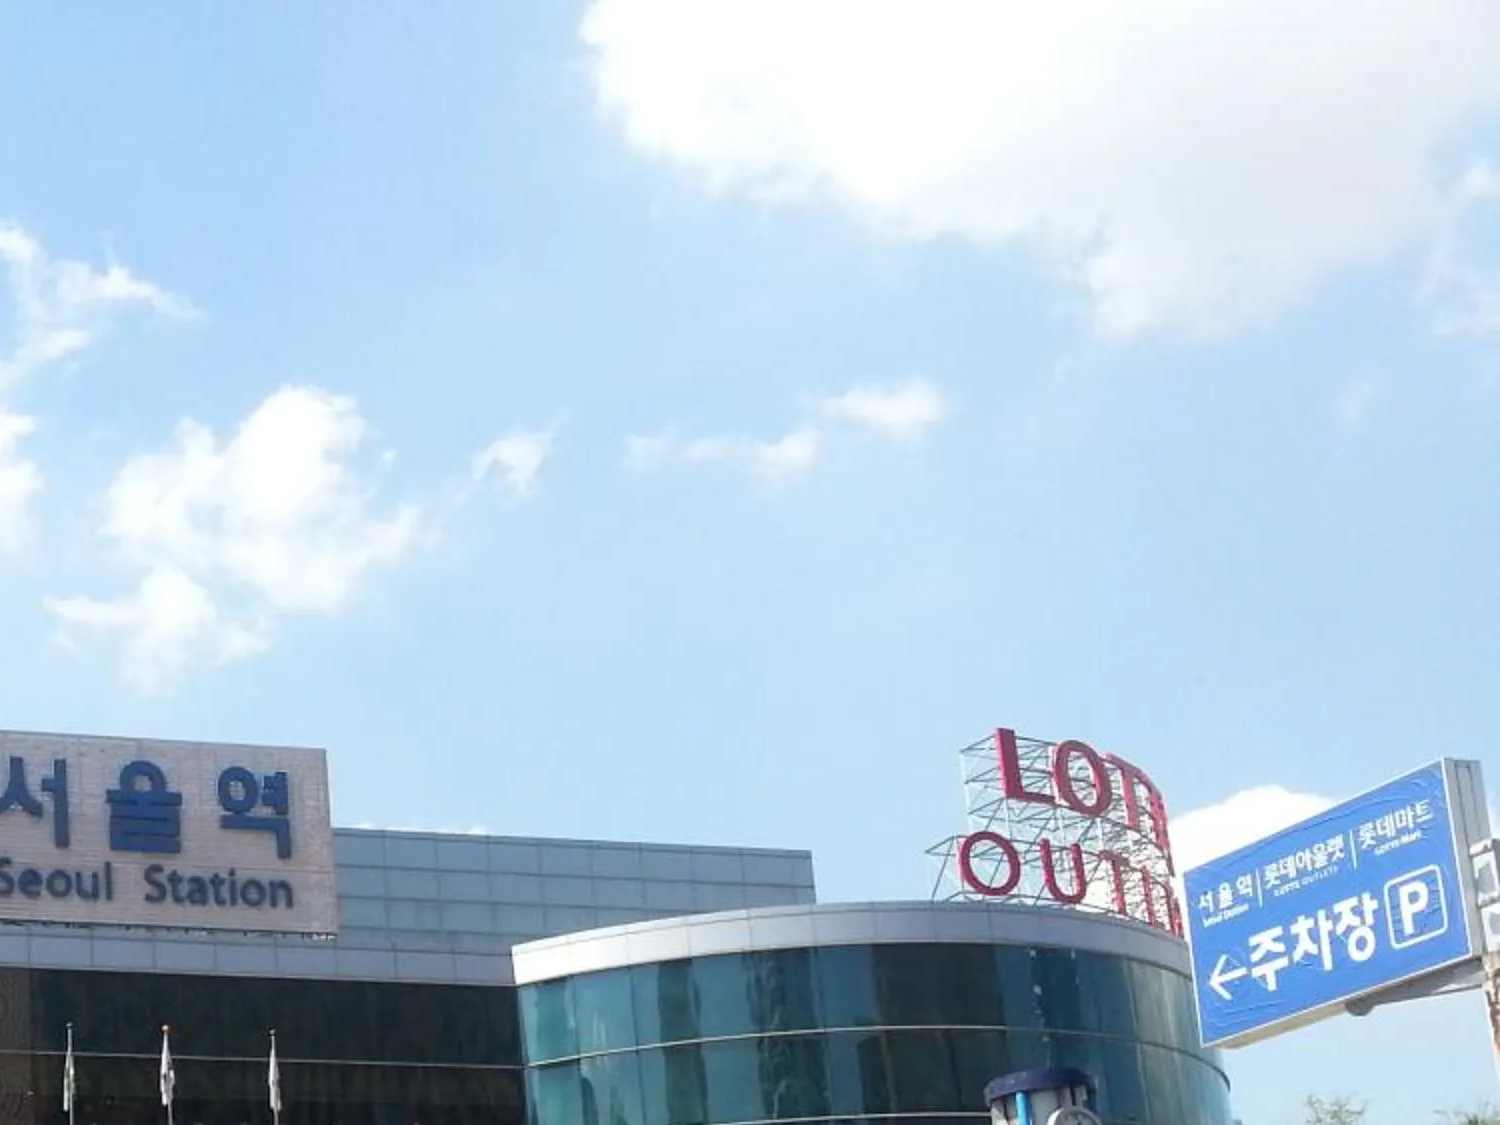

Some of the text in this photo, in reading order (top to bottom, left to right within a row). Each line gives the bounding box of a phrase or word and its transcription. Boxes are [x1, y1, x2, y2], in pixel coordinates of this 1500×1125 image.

[144, 864, 293, 909] Station
[1198, 798, 1434, 913] 서울역 롯데아울렛 롯데마트
[1248, 880, 1429, 992] 주차장 P
